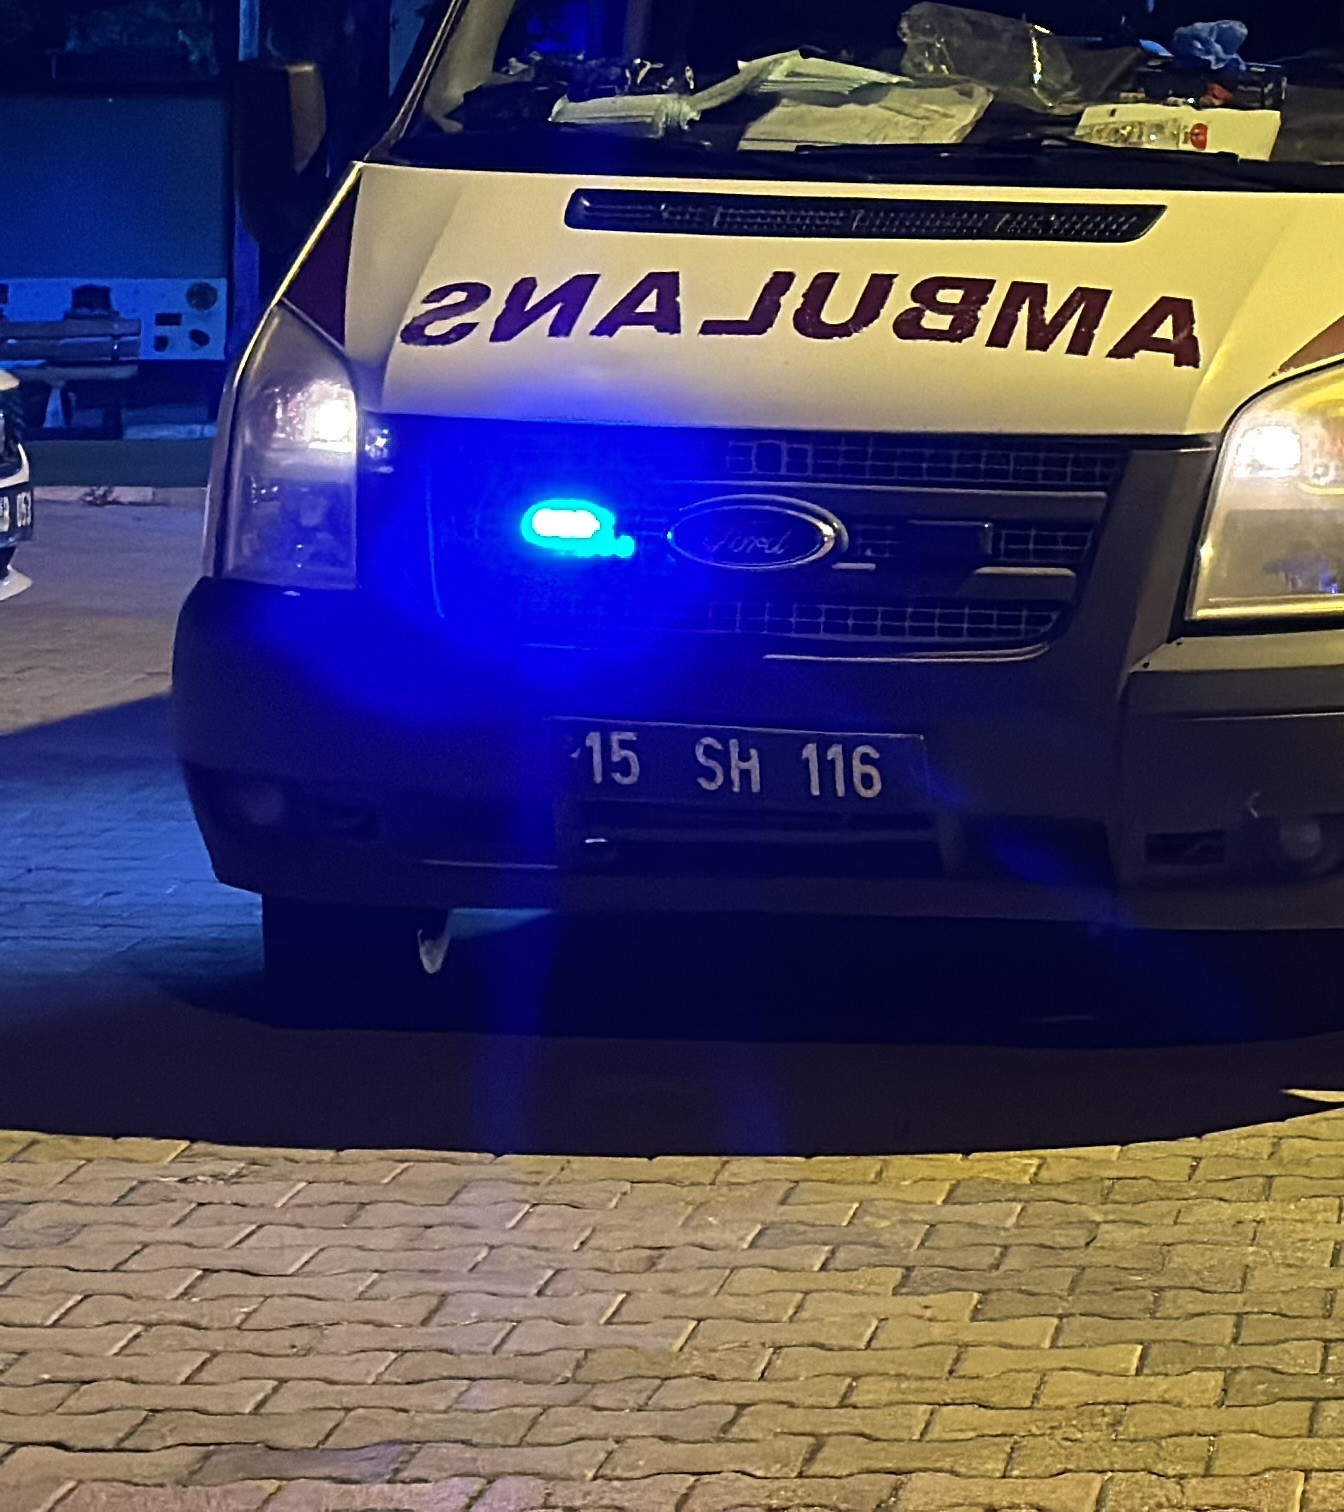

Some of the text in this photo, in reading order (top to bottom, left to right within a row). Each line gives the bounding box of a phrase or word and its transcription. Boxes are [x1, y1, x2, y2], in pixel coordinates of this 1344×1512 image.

[584, 730, 882, 798] 15 SH 116
